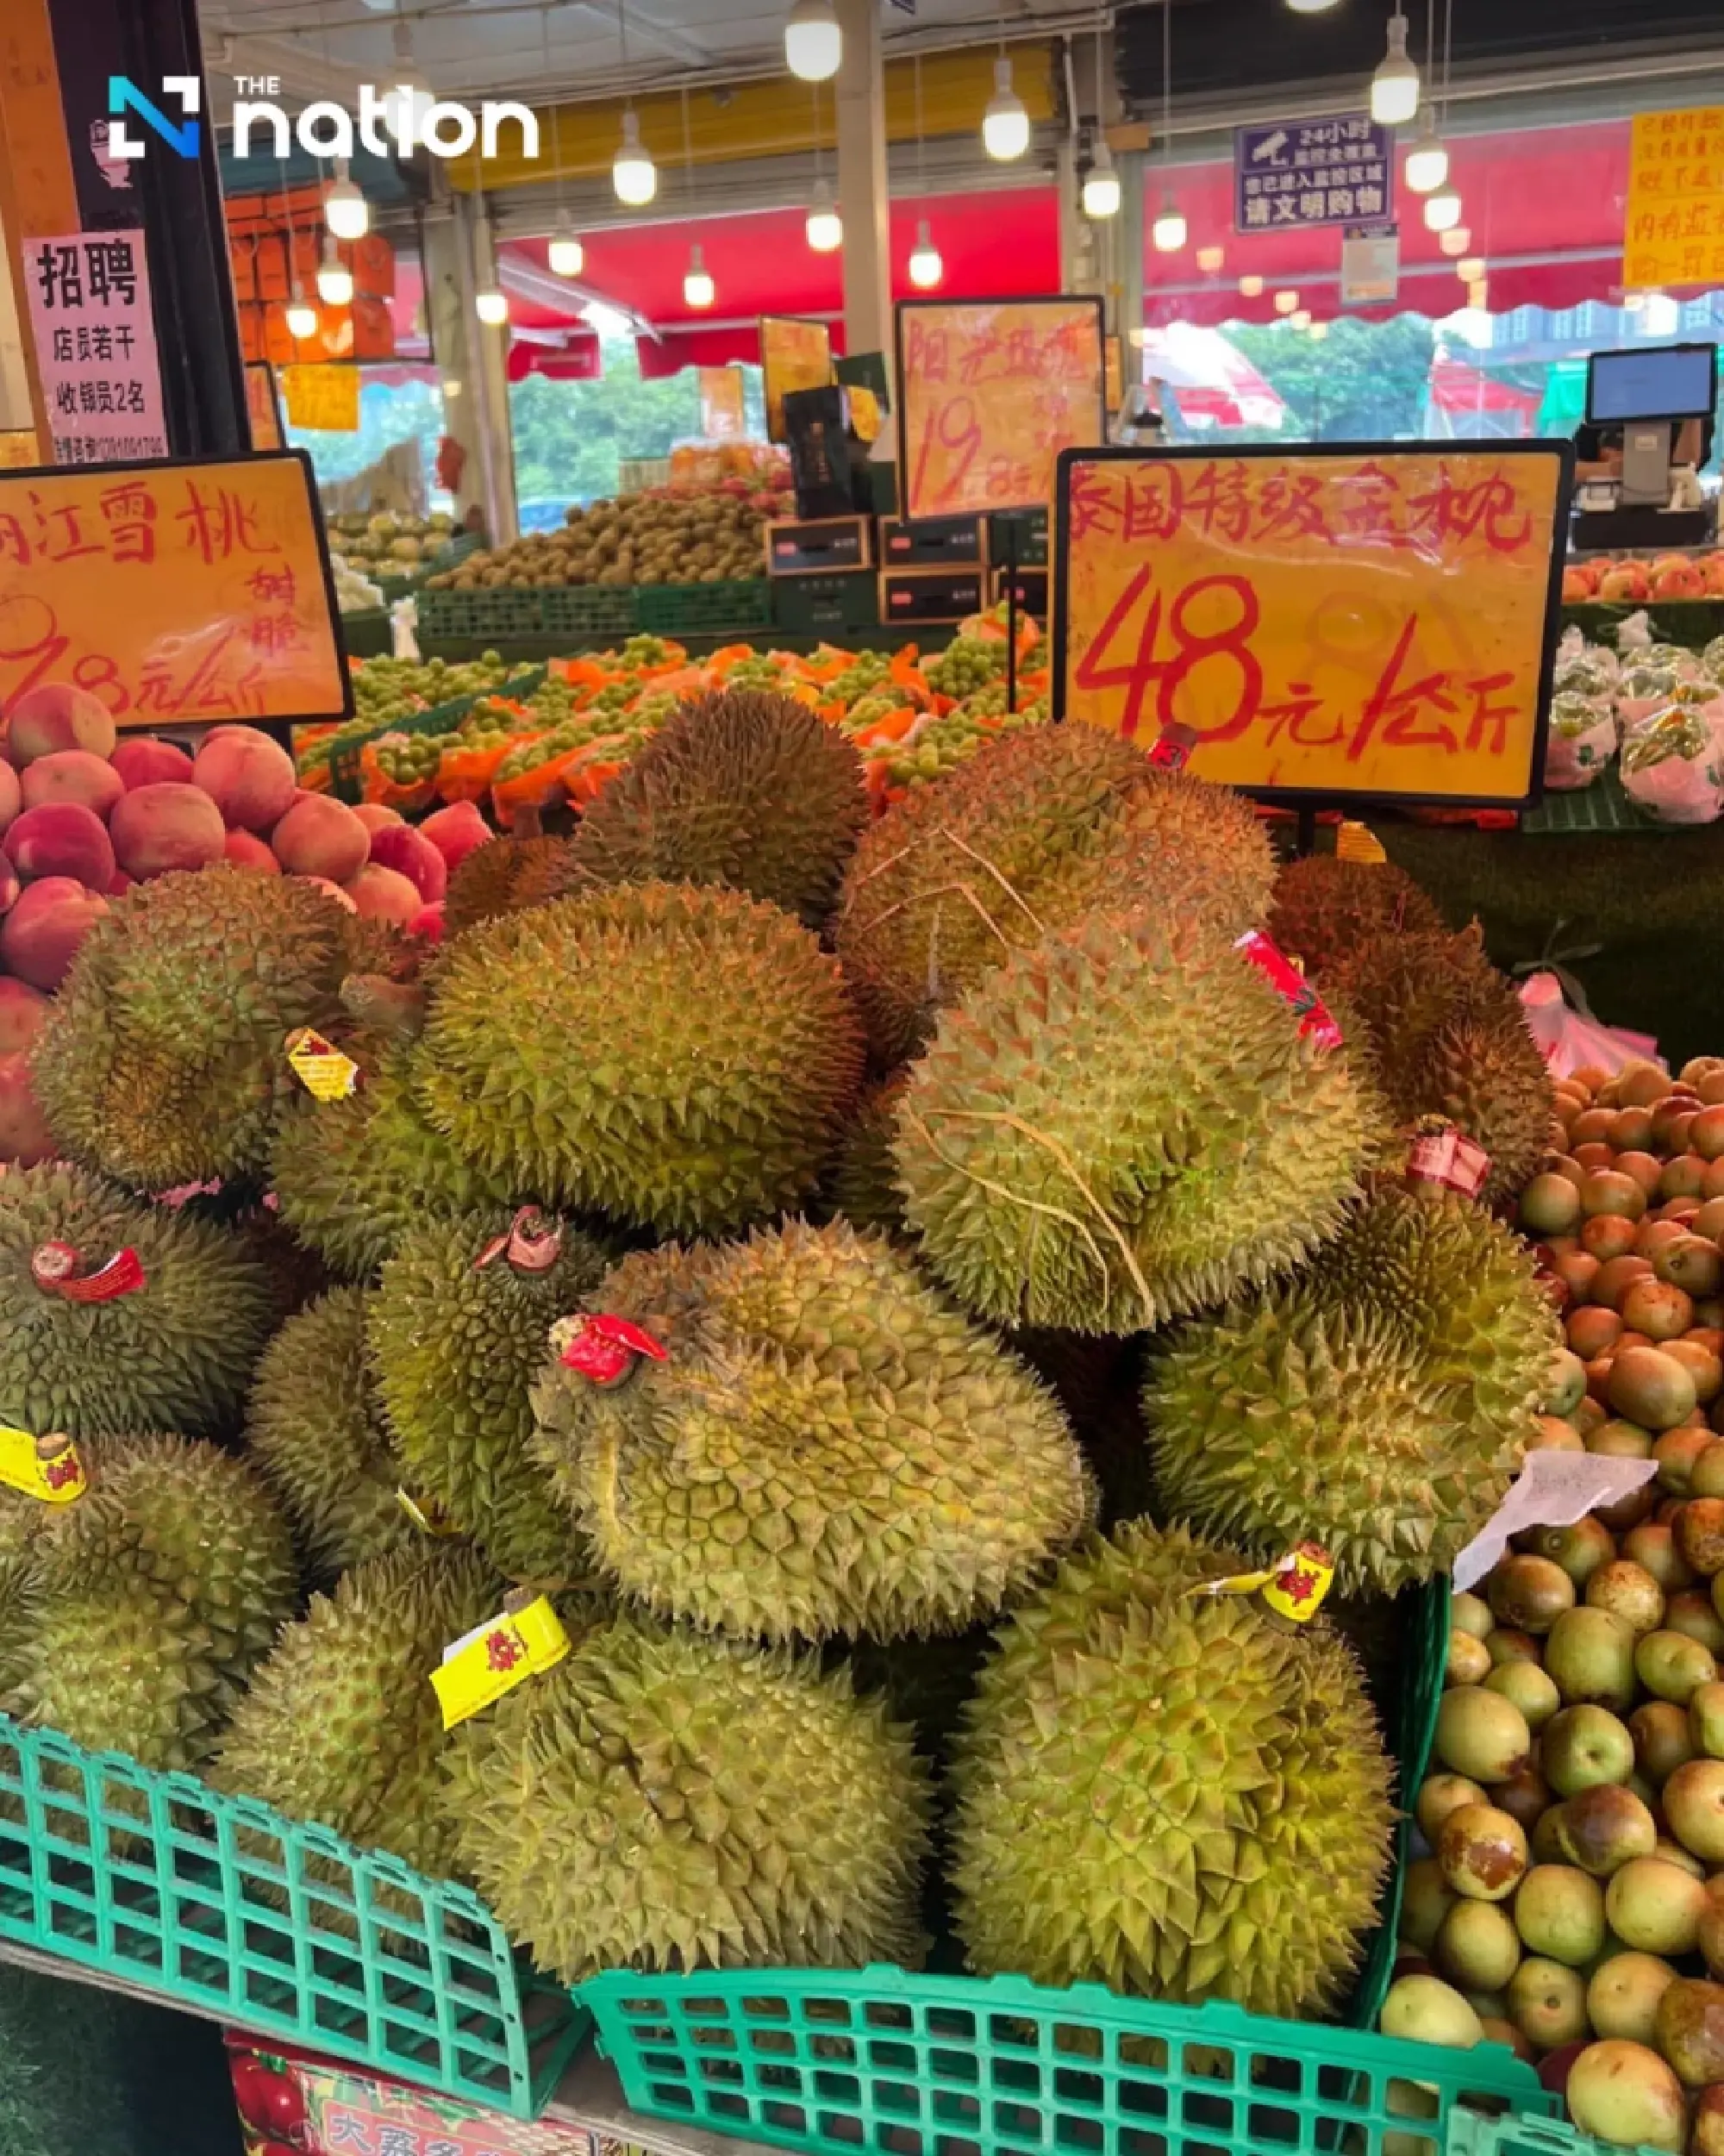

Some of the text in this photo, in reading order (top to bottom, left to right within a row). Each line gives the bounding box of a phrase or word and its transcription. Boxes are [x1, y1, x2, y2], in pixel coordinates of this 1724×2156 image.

[1246, 184, 1382, 224] 请文明购物
[37, 237, 137, 309] 招聘
[53, 325, 135, 362] 店员若干
[1069, 459, 1533, 553] 泰国特级金枕
